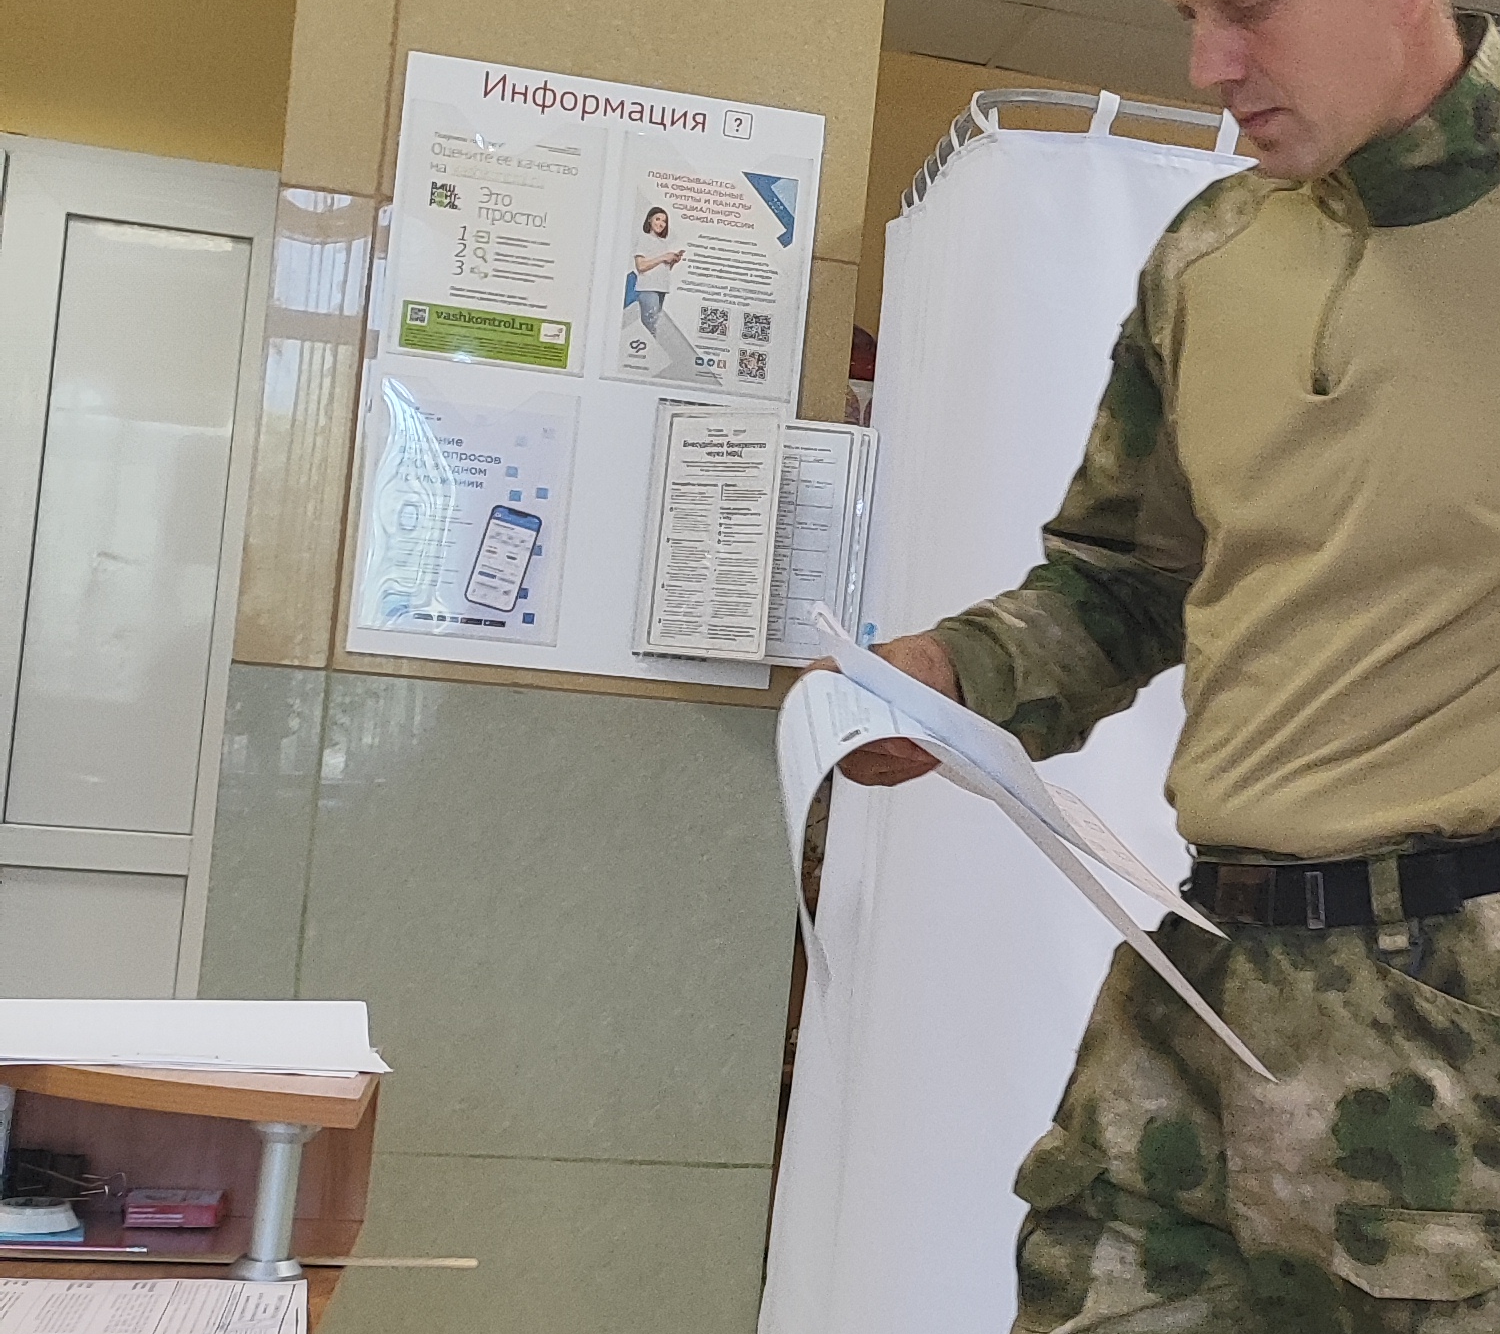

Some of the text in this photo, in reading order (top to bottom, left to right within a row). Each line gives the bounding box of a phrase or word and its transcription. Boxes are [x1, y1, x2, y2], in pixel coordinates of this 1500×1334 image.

[482, 70, 708, 133] Информация
[430, 161, 447, 174] на
[431, 142, 494, 165] Оцените
[517, 160, 579, 177] качество
[478, 186, 513, 207] Это
[477, 206, 548, 229] просто!
[457, 225, 467, 242] 1
[453, 242, 467, 258] 2
[451, 260, 465, 276] 3
[435, 309, 534, 333] vashkontrol.ru
[441, 450, 502, 465] опросов
